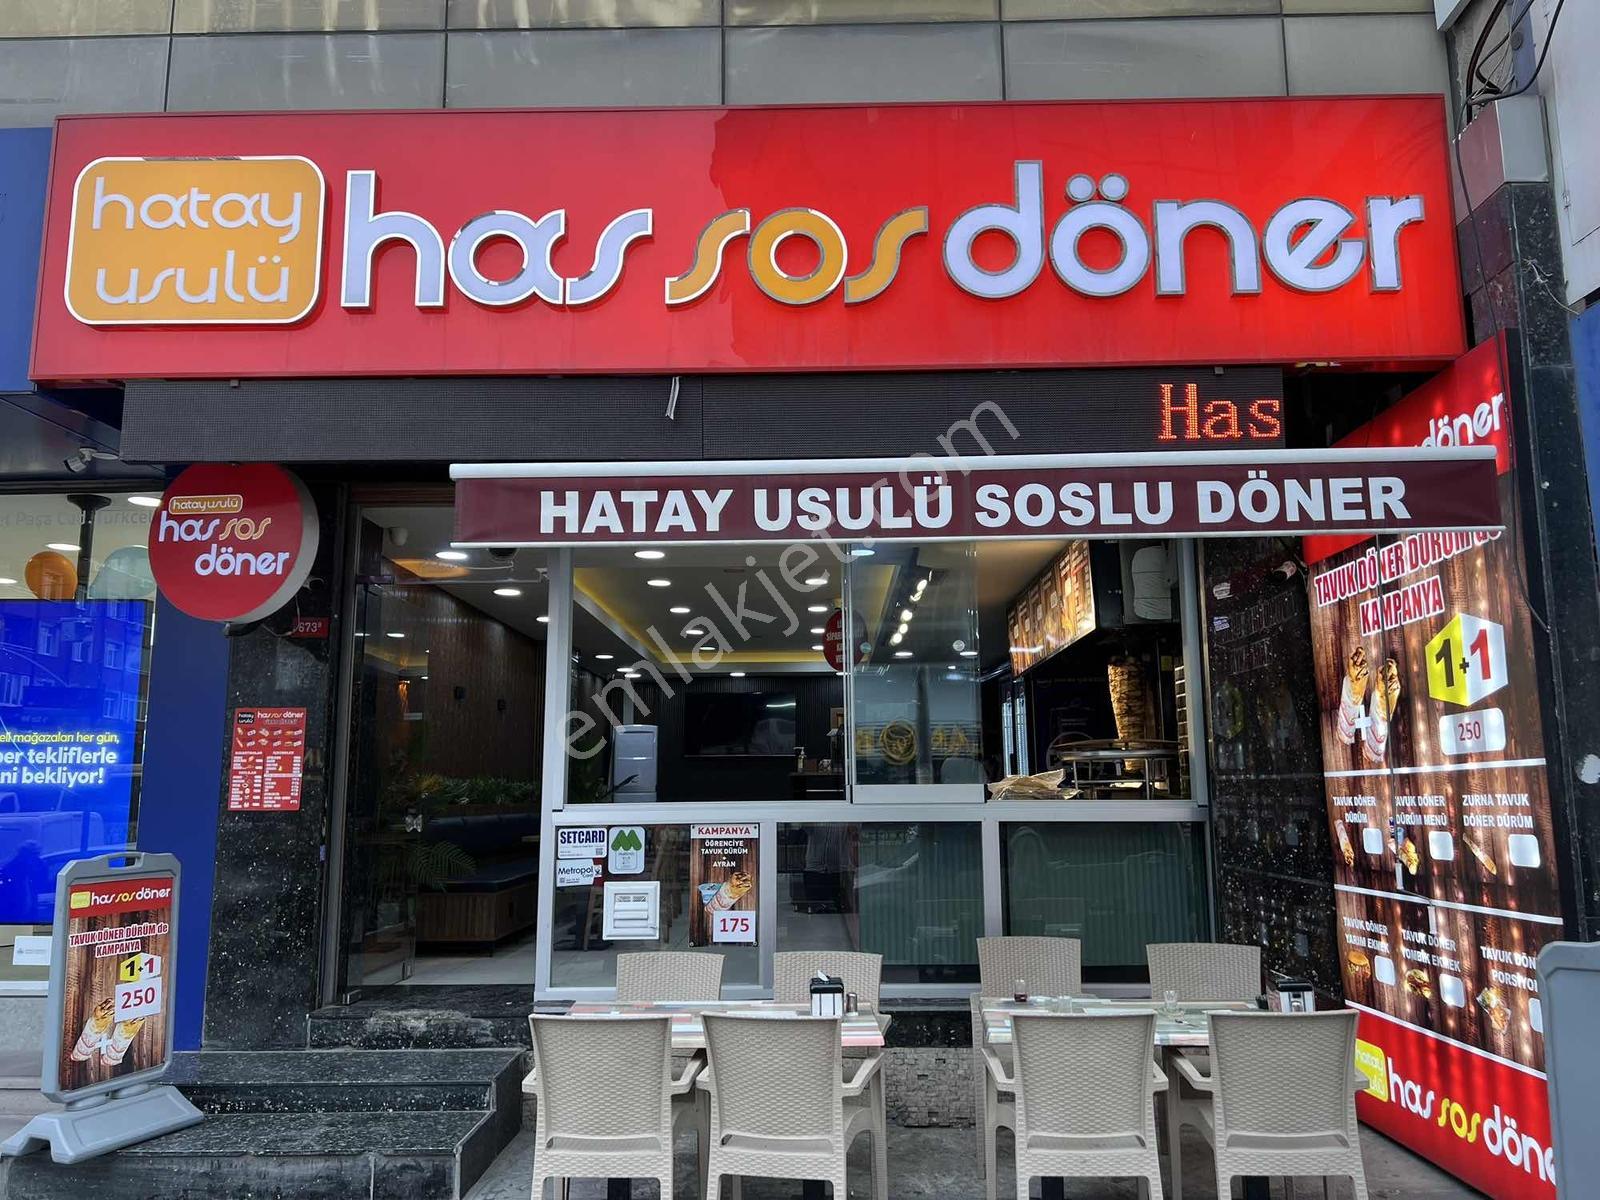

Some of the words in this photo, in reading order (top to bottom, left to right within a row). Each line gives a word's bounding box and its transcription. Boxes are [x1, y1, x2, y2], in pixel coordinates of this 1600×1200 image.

[92, 177, 302, 245] hatay
[340, 169, 653, 308] has
[665, 205, 929, 307] sos
[943, 160, 1424, 299] döner
[95, 250, 289, 304] usulü
[1158, 383, 1280, 439] Has
[1421, 393, 1503, 448] döner
[172, 499, 206, 511] hatay
[207, 497, 238, 508] usulü
[538, 489, 734, 534] HATAY
[753, 476, 953, 532] USULÜ
[975, 479, 1174, 528] SOSLU
[1197, 468, 1410, 524] DÖNER
[158, 510, 220, 542] has
[219, 517, 272, 541] sos
[194, 543, 289, 576] döner
[1315, 562, 1358, 606] TAVUK
[1356, 547, 1406, 592] DÖNER
[1360, 575, 1445, 637] KAMPANYA
[1435, 628, 1492, 689] 1+1
[282, 710, 304, 718] döner
[76, 732, 94, 742] her
[96, 732, 119, 744] gün,
[1457, 721, 1481, 742] 250
[28, 747, 117, 764] tekliflerle
[22, 767, 104, 787] bekliyor!
[1333, 796, 1353, 806] TAVUK
[1353, 795, 1376, 806] DÖNER
[1395, 796, 1416, 806] AVUK
[1417, 795, 1445, 806] DÖNER
[1462, 794, 1494, 806] ZURNA
[1495, 794, 1530, 807] TAVUK
[1344, 813, 1368, 823] DÜRÜM
[1396, 813, 1422, 825] DÜRÜM
[1424, 814, 1447, 826] MENÜ
[1463, 814, 1495, 827] DÖNER
[1496, 813, 1533, 829] DÜRÜM
[560, 830, 605, 844] SETCARD
[698, 827, 751, 835] KAMPANYA
[558, 866, 593, 876] Metropol
[91, 892, 115, 906] has
[115, 892, 135, 903] sos
[135, 887, 171, 900] döner
[70, 932, 96, 946] TAVUK
[97, 926, 124, 943] DÖNER
[126, 922, 156, 938] DÜRÜM
[157, 923, 169, 934] de
[720, 918, 749, 932] 175
[1343, 917, 1365, 931] TAVUK
[1366, 919, 1388, 935] DÖNER
[1402, 929, 1427, 945] TAVUK
[95, 941, 141, 958] KAMPANYA
[1480, 946, 1513, 965] TAVUK
[126, 957, 155, 977] 1+1
[1432, 953, 1461, 973] EKMEK
[121, 987, 156, 1010] 250
[1387, 1056, 1435, 1119] has
[1438, 1098, 1481, 1143] sos
